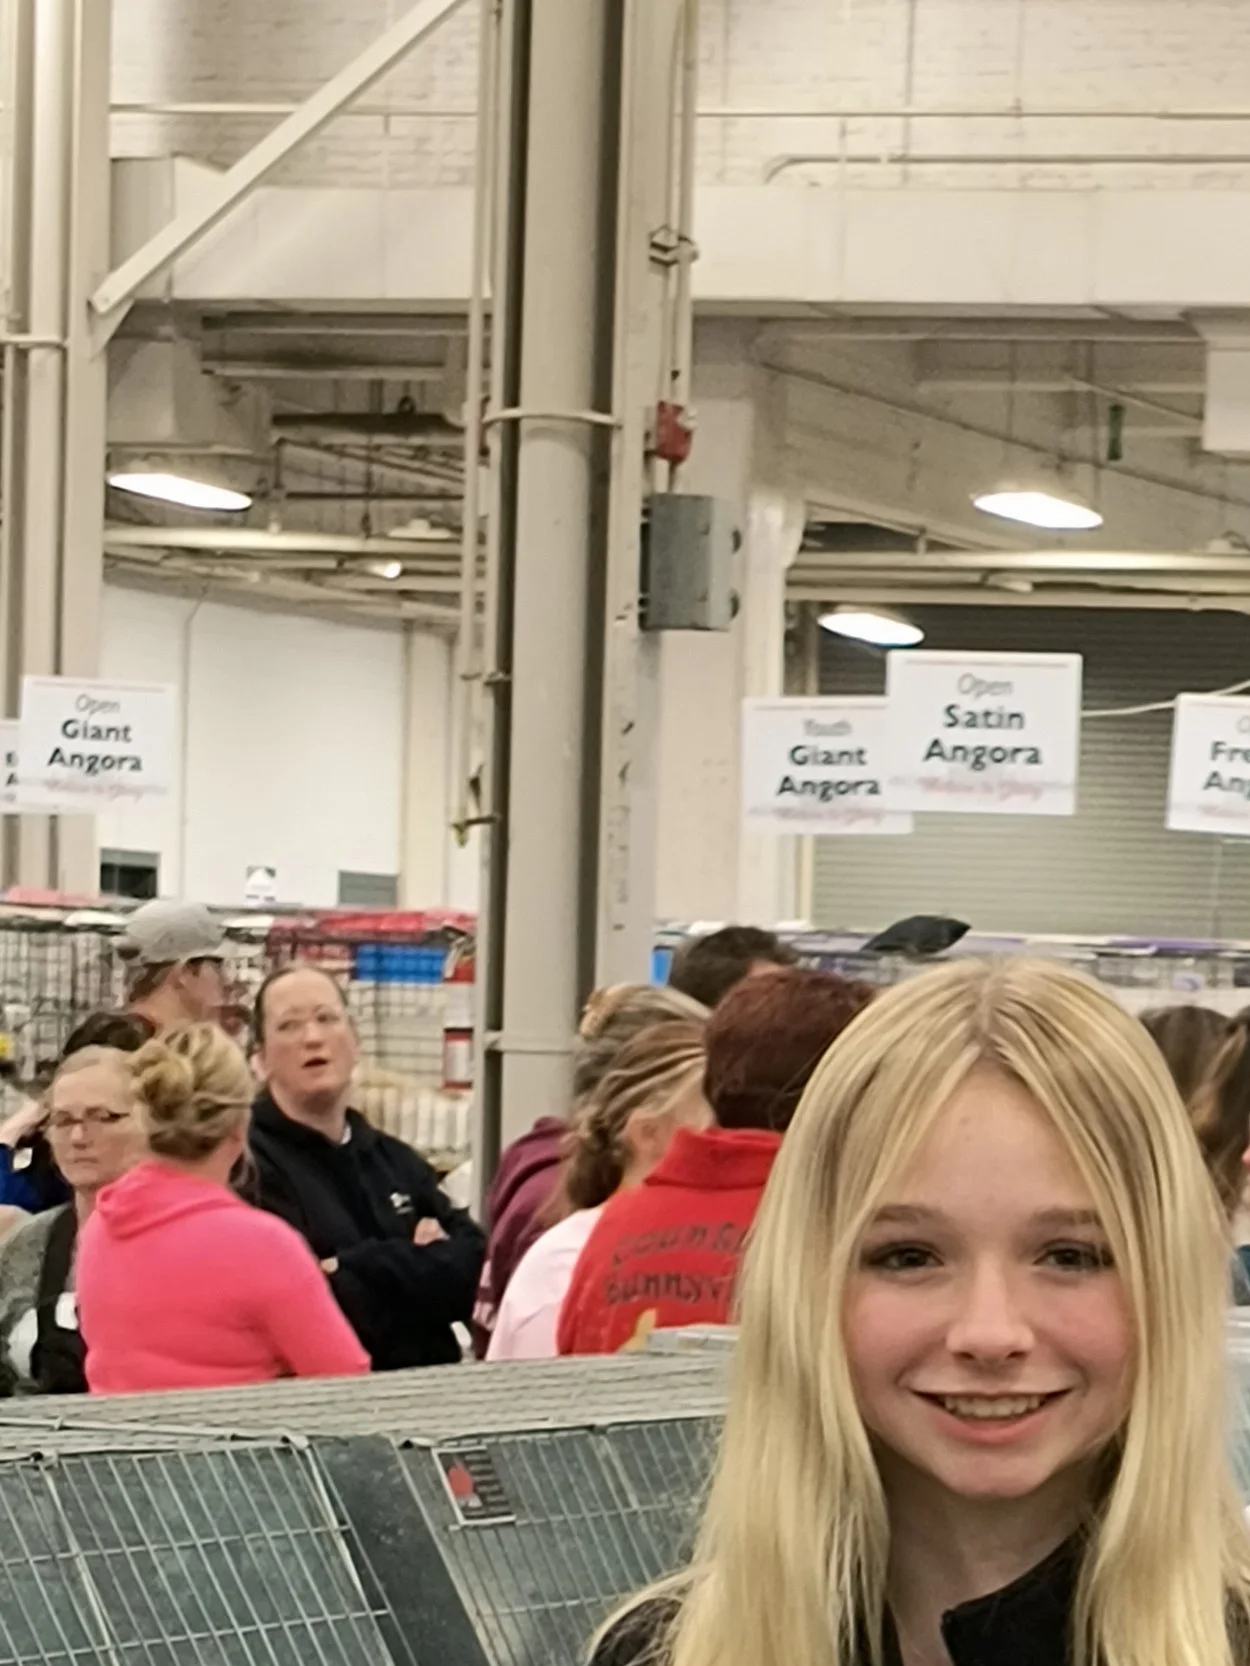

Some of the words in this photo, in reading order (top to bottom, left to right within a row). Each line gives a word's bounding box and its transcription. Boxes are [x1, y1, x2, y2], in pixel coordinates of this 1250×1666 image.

[958, 672, 1014, 699] Open
[75, 693, 121, 715] Open
[943, 703, 1026, 731] Satin
[61, 718, 133, 744] Giant
[47, 747, 143, 776] Angora
[788, 744, 868, 766] Giant
[922, 738, 1043, 771] Angora
[776, 775, 881, 802] Angora
